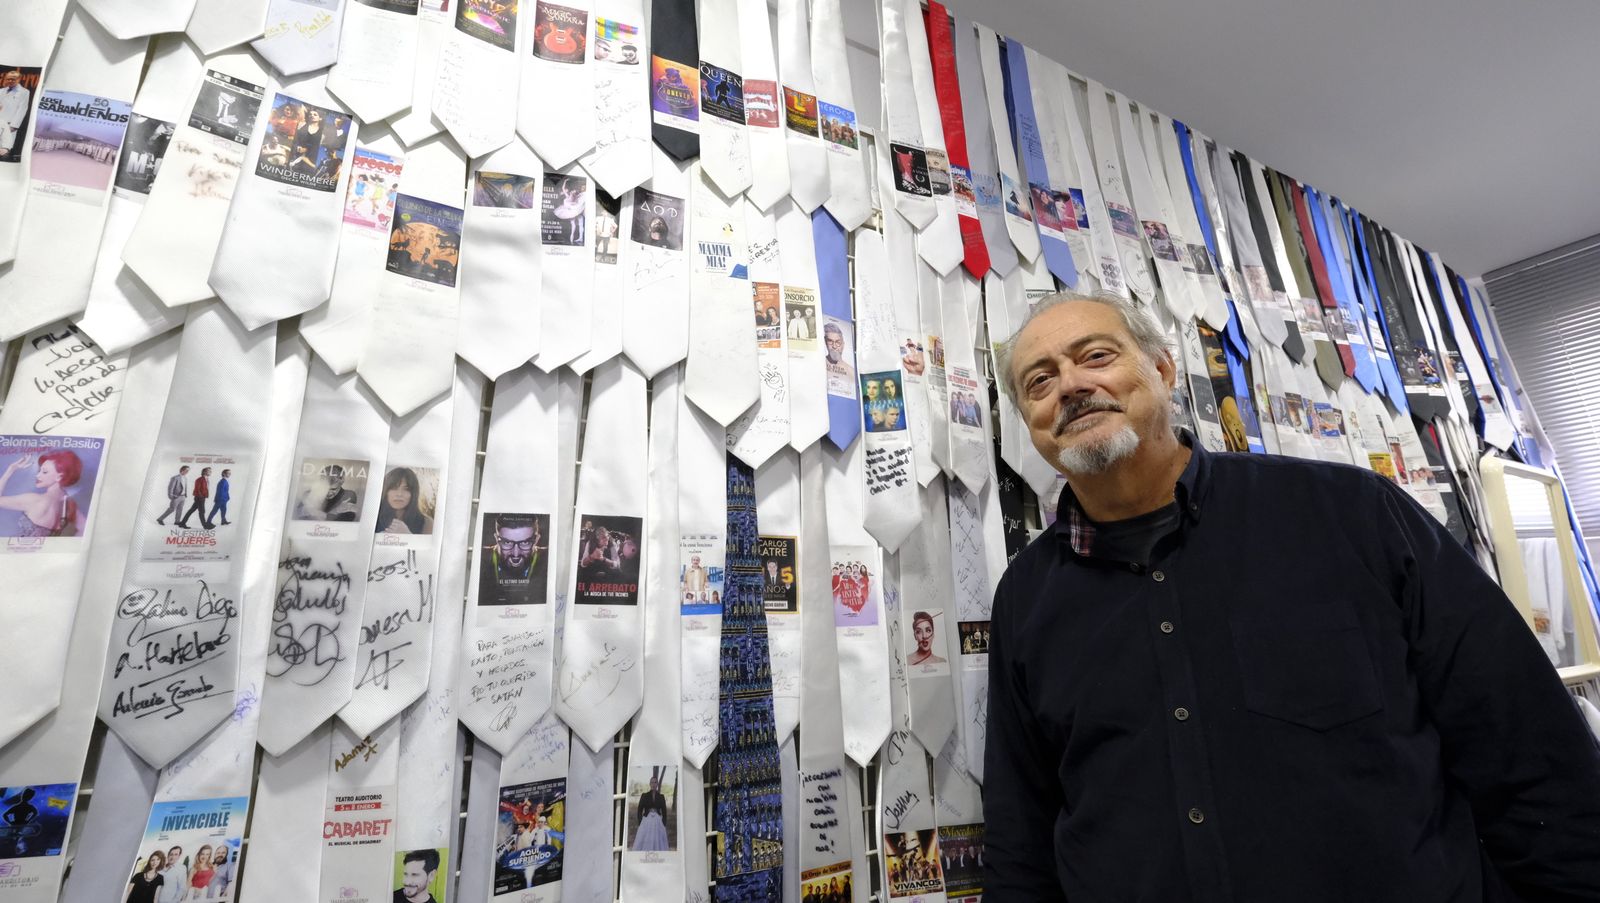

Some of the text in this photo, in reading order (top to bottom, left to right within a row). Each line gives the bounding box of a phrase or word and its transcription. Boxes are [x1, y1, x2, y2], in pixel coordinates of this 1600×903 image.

[701, 65, 742, 88] QUEEN
[94, 97, 109, 107] 50
[260, 162, 336, 186] WINDERMERE
[698, 243, 732, 258] MAMMA
[706, 255, 726, 268] MIA!
[784, 294, 815, 302] ONSORCIO
[0, 436, 101, 449] Paloma San Basilio
[301, 462, 367, 479] DALMA
[170, 528, 216, 538] NUESTRAS
[166, 536, 217, 546] MUJERES
[780, 567, 794, 584] 5
[588, 583, 637, 592] ARREBATO
[161, 812, 231, 831] INVENCIBLE
[323, 819, 392, 839] CABARET
[509, 851, 551, 866] SUFRIENDO
[894, 879, 941, 890] VIVANCOS
